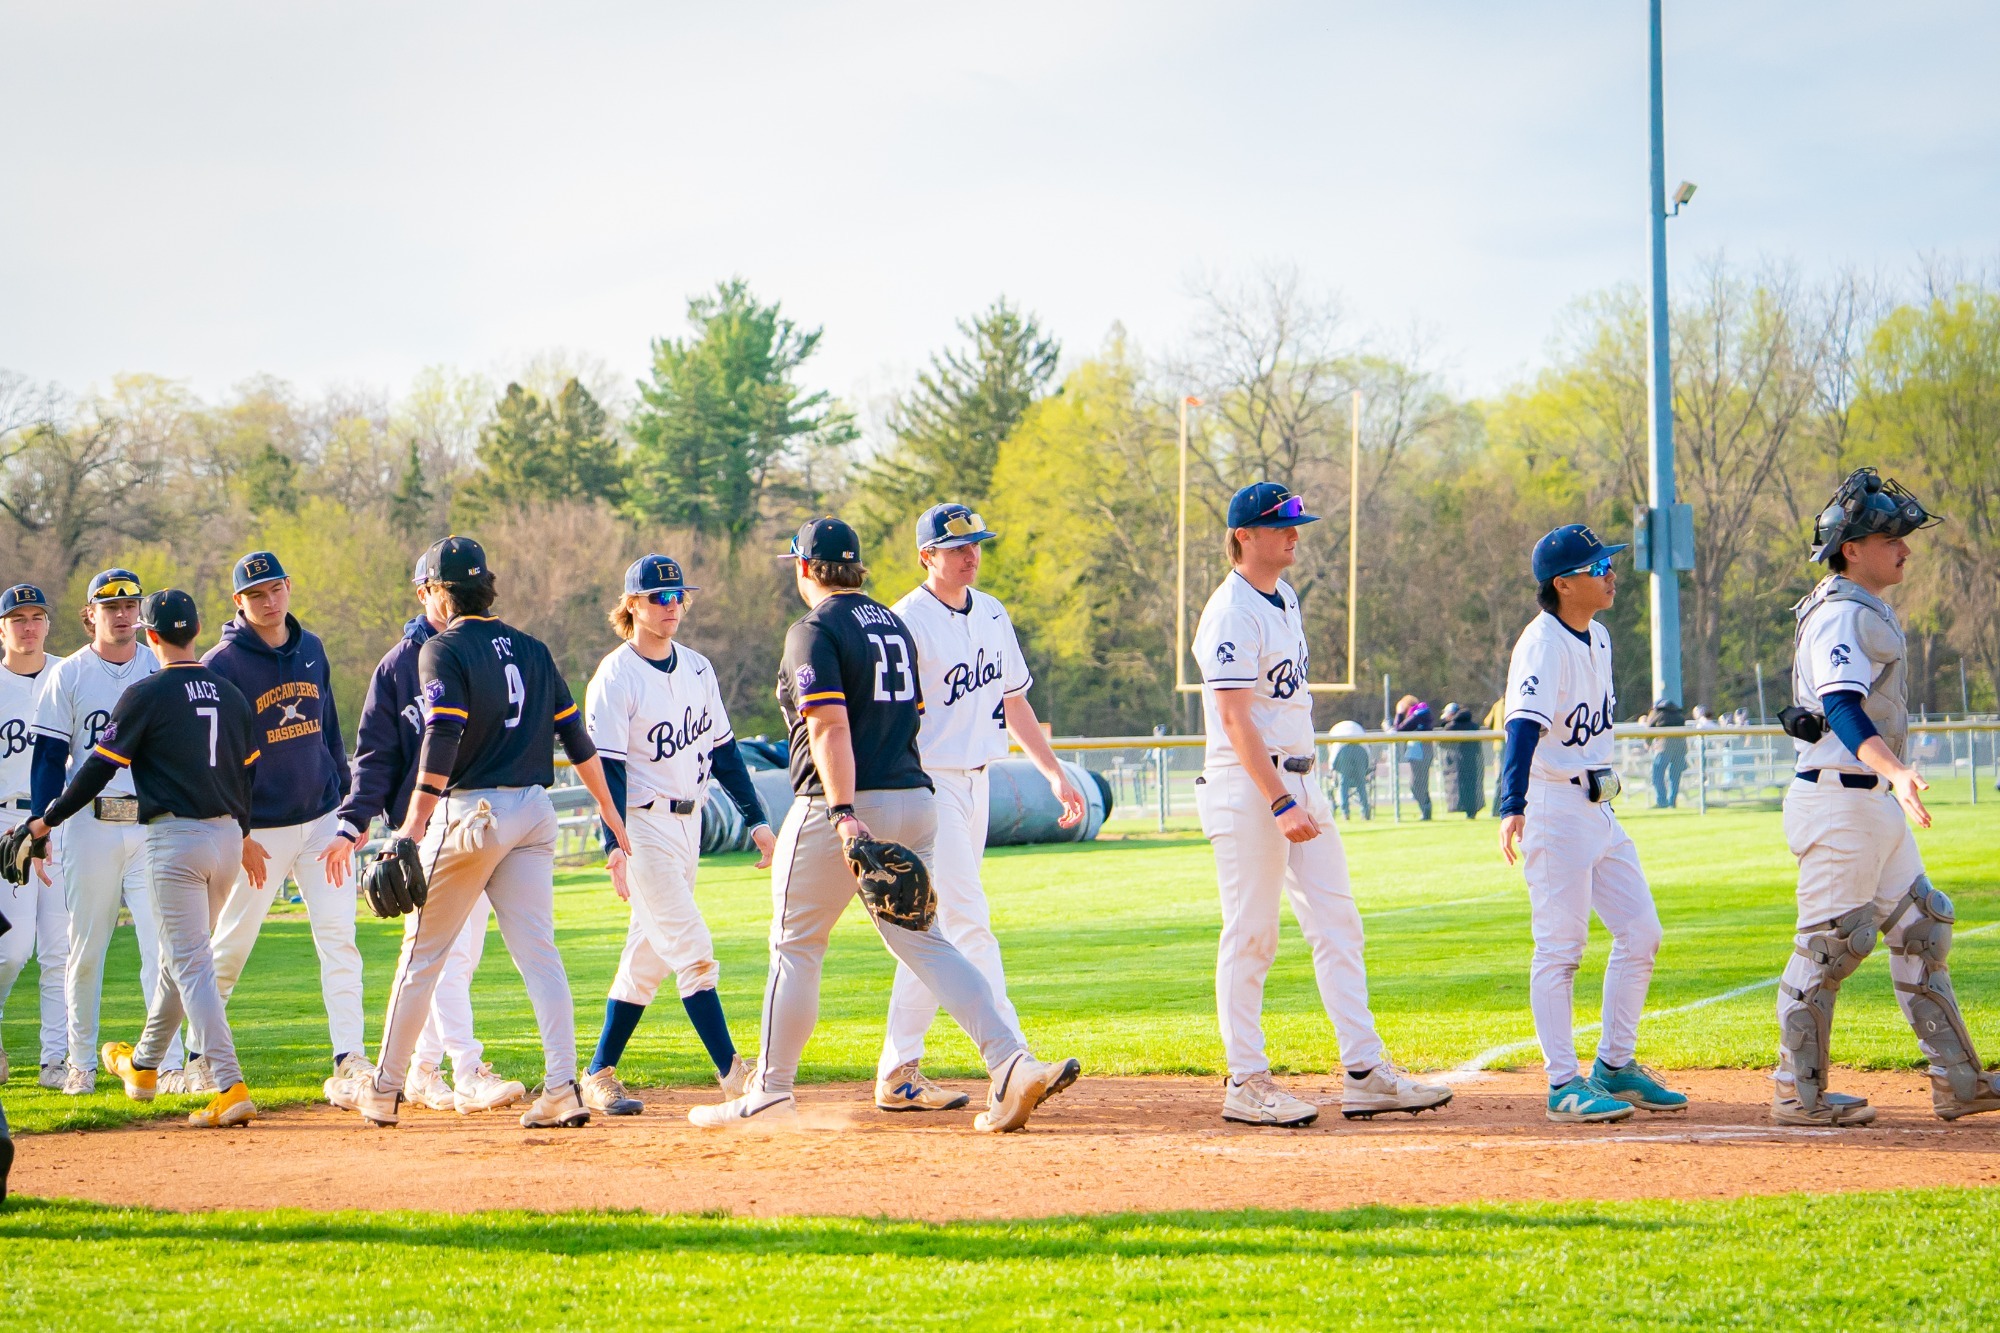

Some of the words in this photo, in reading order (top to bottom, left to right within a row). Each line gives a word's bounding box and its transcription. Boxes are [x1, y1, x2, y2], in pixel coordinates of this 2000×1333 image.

[244, 558, 270, 578] B
[657, 563, 680, 581] B
[14, 588, 37, 602] B
[867, 633, 915, 701] 23
[184, 680, 220, 702] MACE
[504, 663, 526, 728] 9
[196, 707, 218, 767] 7
[266, 719, 321, 744] BASEBALL
